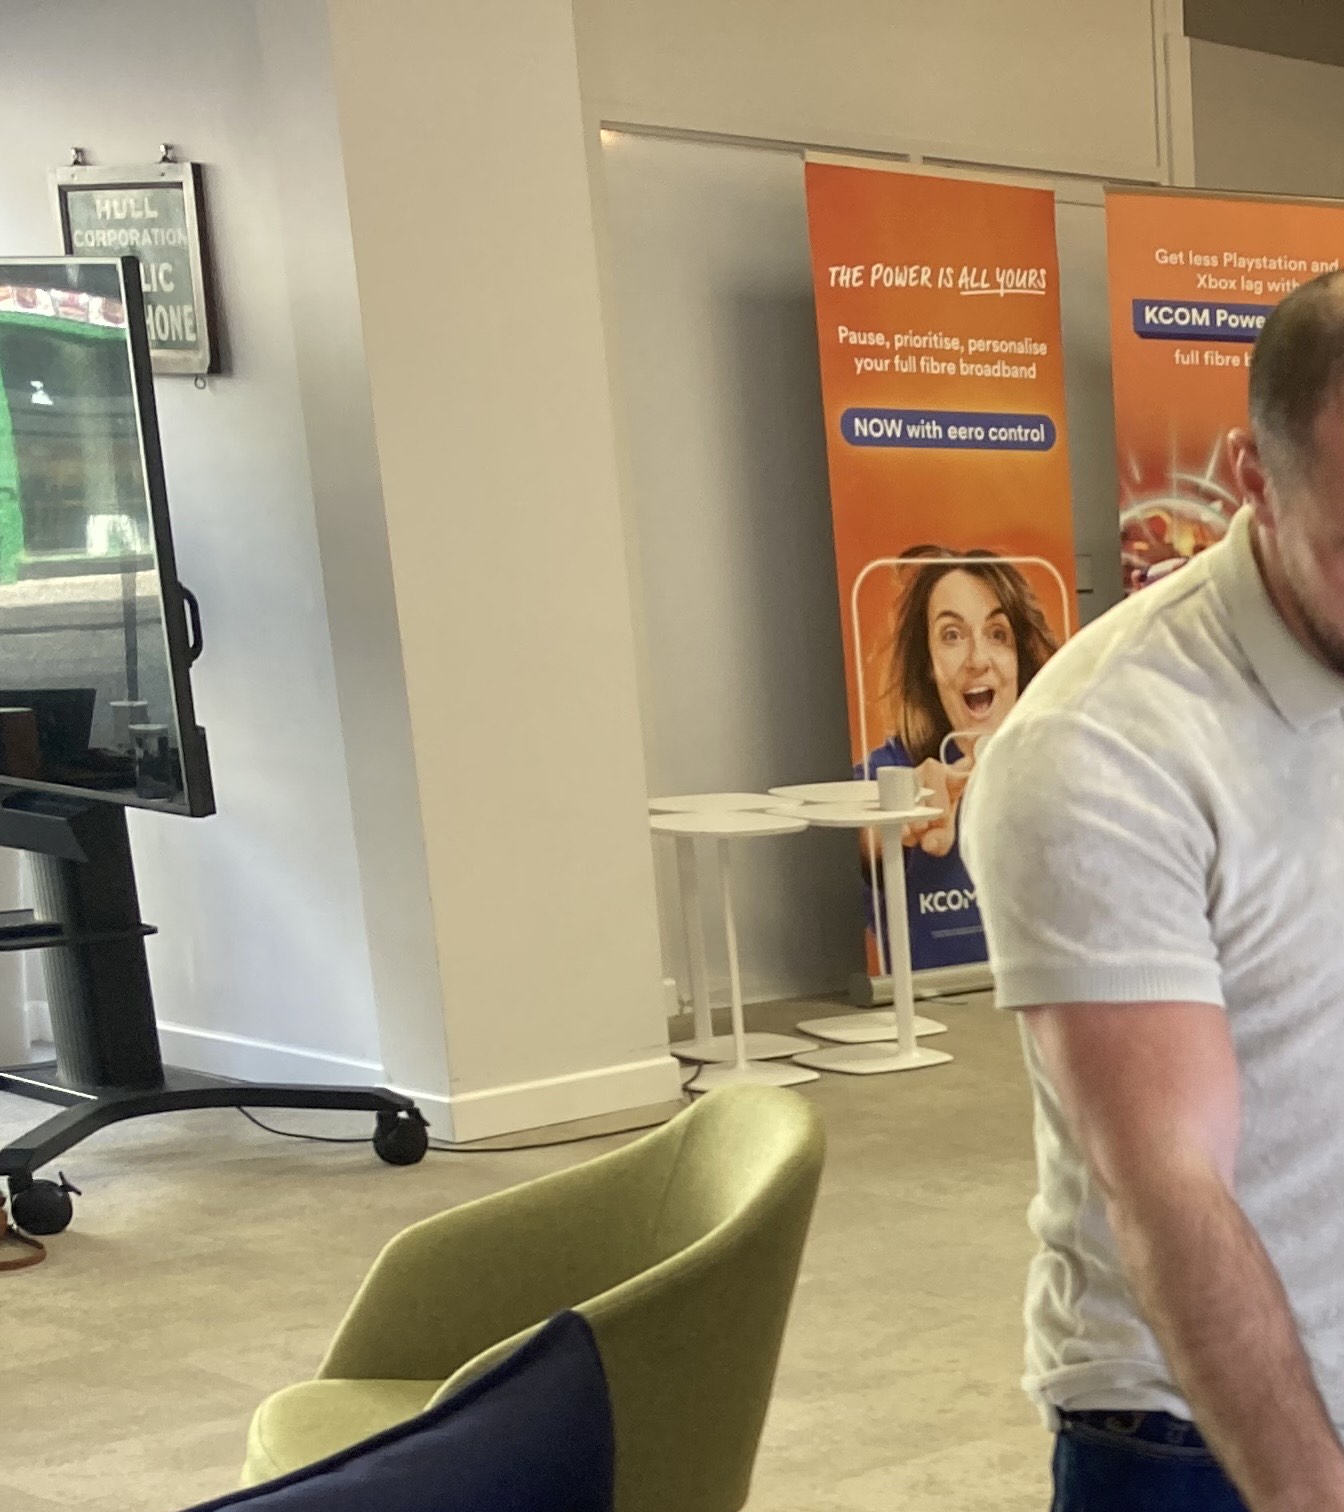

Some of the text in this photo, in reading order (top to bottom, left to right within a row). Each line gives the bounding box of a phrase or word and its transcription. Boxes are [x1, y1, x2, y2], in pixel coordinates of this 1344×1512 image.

[96, 197, 158, 220] HULL
[74, 228, 187, 247] CORPORATION
[1155, 248, 1339, 274] Get less Playstation and
[140, 262, 175, 293] LIC
[828, 265, 1046, 295] THE POWER IS ALL YOURS
[1196, 274, 1301, 296] Xbox lag with
[1144, 306, 1266, 330] KCOM Powe
[838, 326, 1048, 356] Pause, prioritise, personalise
[854, 355, 1036, 380] your full fibre broadband
[1174, 350, 1239, 368] full fibre
[854, 417, 1046, 444] NOW with eero control
